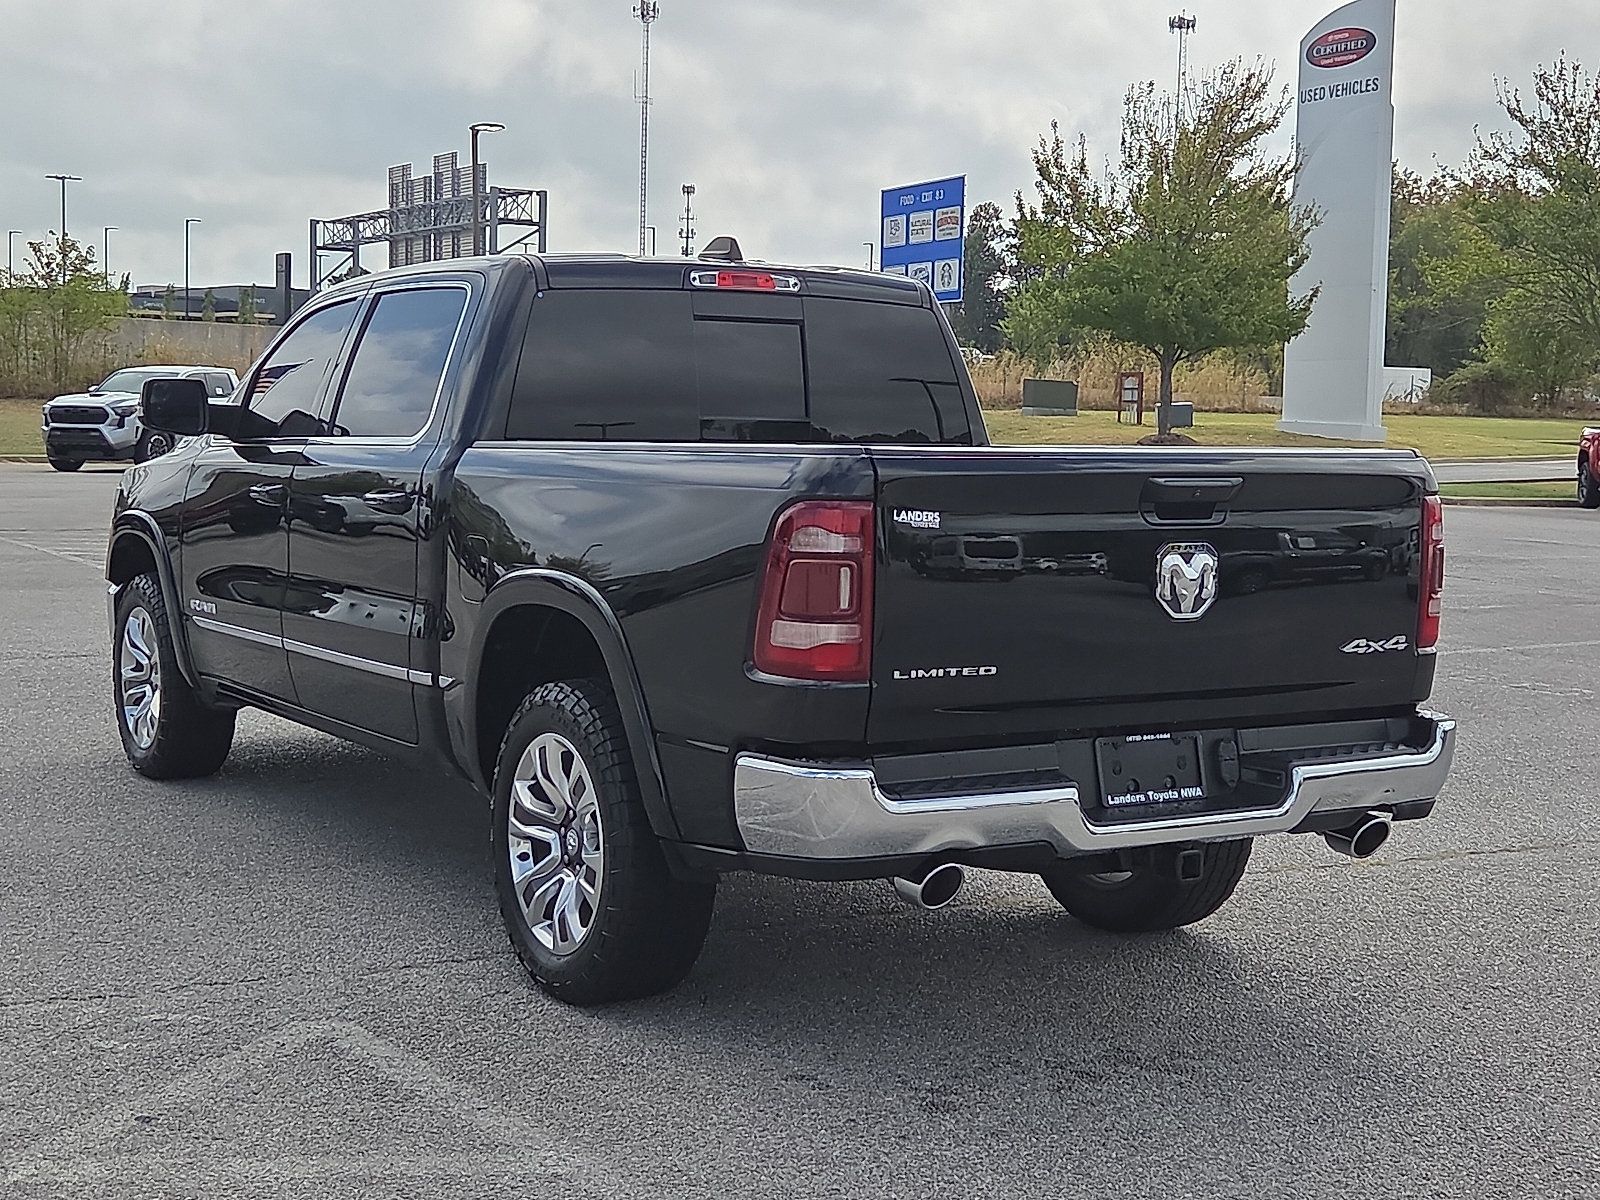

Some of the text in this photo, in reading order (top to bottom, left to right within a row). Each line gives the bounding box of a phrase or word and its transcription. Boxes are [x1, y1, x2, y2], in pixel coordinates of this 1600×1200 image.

[1313, 39, 1367, 57] CERTIFIED
[1300, 77, 1379, 104] USED VEHICLES
[899, 194, 915, 207] FOOD
[921, 190, 933, 203] EXIT
[893, 509, 941, 522] LANDERS
[190, 599, 216, 615] RAM
[893, 666, 997, 679] LIMITED
[1107, 786, 1203, 805] Landers Toyota NWA
